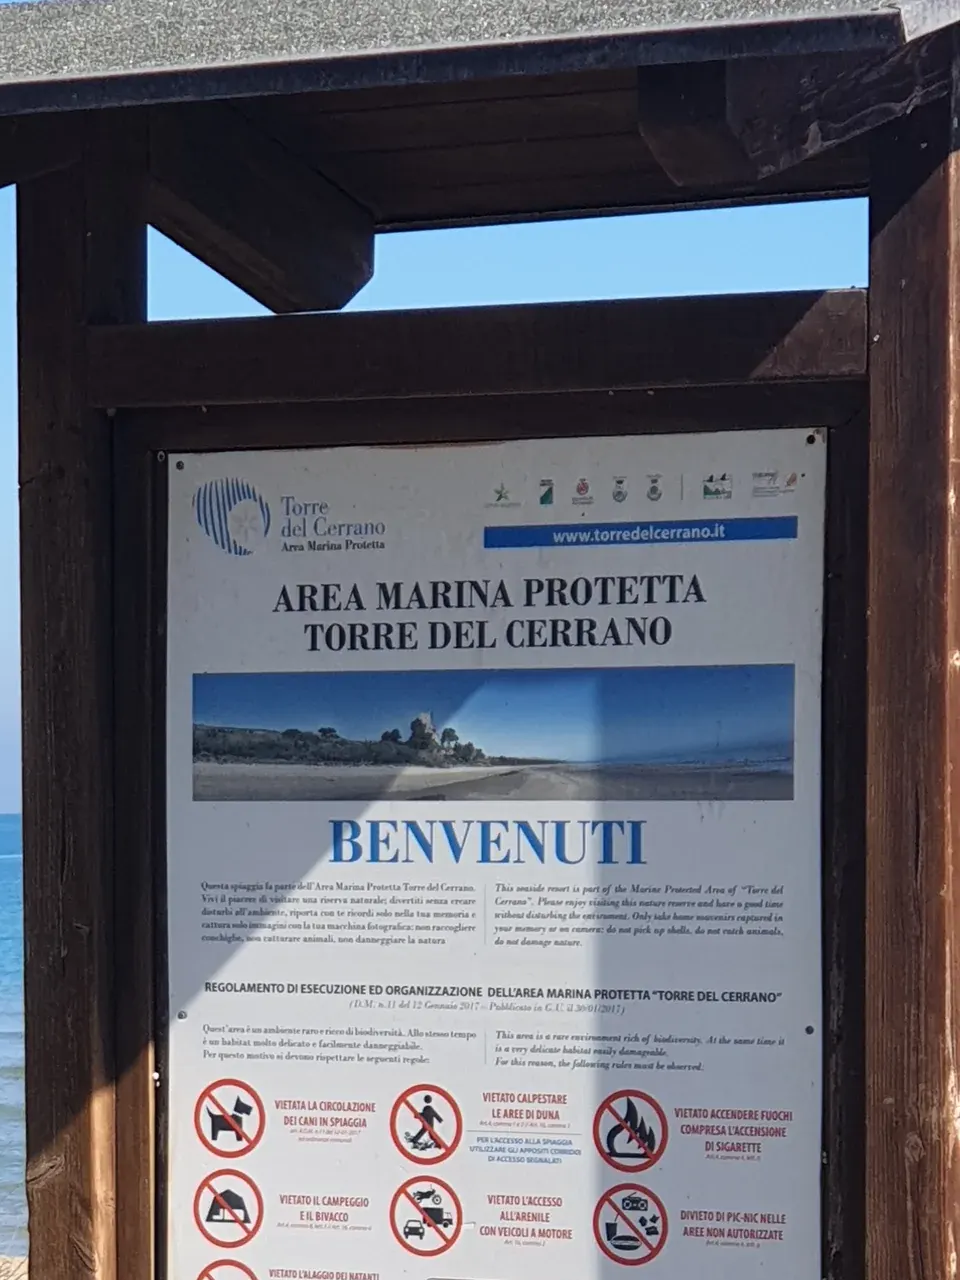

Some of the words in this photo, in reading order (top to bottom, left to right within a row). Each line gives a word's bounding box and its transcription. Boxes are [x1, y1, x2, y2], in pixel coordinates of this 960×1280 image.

[281, 517, 306, 537] del
[313, 516, 385, 536] Cerrano
[553, 525, 725, 543] www.torredelcerrano.it
[281, 541, 304, 551] Area
[308, 540, 342, 551] Marina
[345, 538, 385, 550] Protetta
[272, 583, 366, 612] AREA
[376, 579, 514, 611] MARINA
[523, 574, 707, 606] PROTETTA
[303, 621, 418, 651] TORRE
[427, 620, 496, 649] DEL
[505, 616, 672, 648] CERRANO
[328, 820, 647, 865] BENVENUTI
[205, 981, 285, 993] REGOLAMENTO
[287, 983, 298, 993] DI
[300, 983, 366, 994] ESECUZIONE
[369, 984, 383, 995] ED
[385, 985, 482, 997] ORGANIZZAZIONE
[488, 986, 543, 998] DELL'AREA
[546, 987, 592, 999] MARINA
[594, 989, 651, 1001] PROTETTA
[697, 991, 719, 1002] DEL
[482, 1092, 515, 1102] VIETATO
[517, 1093, 568, 1104] CALPESTARE
[275, 1100, 306, 1110] VIETATA
[308, 1101, 317, 1110] LA
[319, 1101, 376, 1112] CIRCOLAZIONE
[492, 1108, 501, 1118] LE
[503, 1108, 524, 1119] AREE
[526, 1109, 534, 1119] DI
[536, 1109, 560, 1120] DUNA
[674, 1108, 708, 1119] VIETATO
[710, 1109, 759, 1121] ACCENDERE
[761, 1110, 794, 1121] FUOCHI
[283, 1115, 296, 1125] DEI
[298, 1116, 317, 1126] CANI
[319, 1117, 328, 1126] IN
[330, 1117, 367, 1128] SPIAGGIA
[680, 1124, 727, 1136] COMPRESA
[728, 1125, 788, 1138] L'ACCENSIONE
[705, 1141, 714, 1152] DI
[716, 1142, 762, 1153] SIGARETTE
[279, 1194, 312, 1205] VIETATO
[313, 1195, 320, 1206] IL
[322, 1196, 369, 1207] CAMPEGGIO
[486, 1194, 520, 1205] VIETATO
[521, 1195, 563, 1207] L'ACCESSO
[299, 1210, 304, 1220] E
[306, 1211, 313, 1221] IL
[315, 1211, 349, 1222] BIVACCO
[499, 1211, 550, 1222] ALL'ARENILE
[680, 1210, 714, 1222] DIVIETO
[715, 1211, 725, 1222] DI
[726, 1212, 759, 1223] PIC-NIC
[760, 1213, 787, 1224] NELLE
[479, 1225, 496, 1236] CON
[498, 1226, 529, 1237] VEICOLI
[530, 1227, 536, 1238] A
[538, 1228, 573, 1239] MOTORE
[682, 1226, 704, 1237] AREE
[706, 1227, 725, 1238] NON
[726, 1228, 784, 1240] AUTORIZZATE
[268, 1268, 298, 1278] VIETATO
[298, 1269, 335, 1280] L'ALAGGIO
[335, 1271, 348, 1280] DEI
